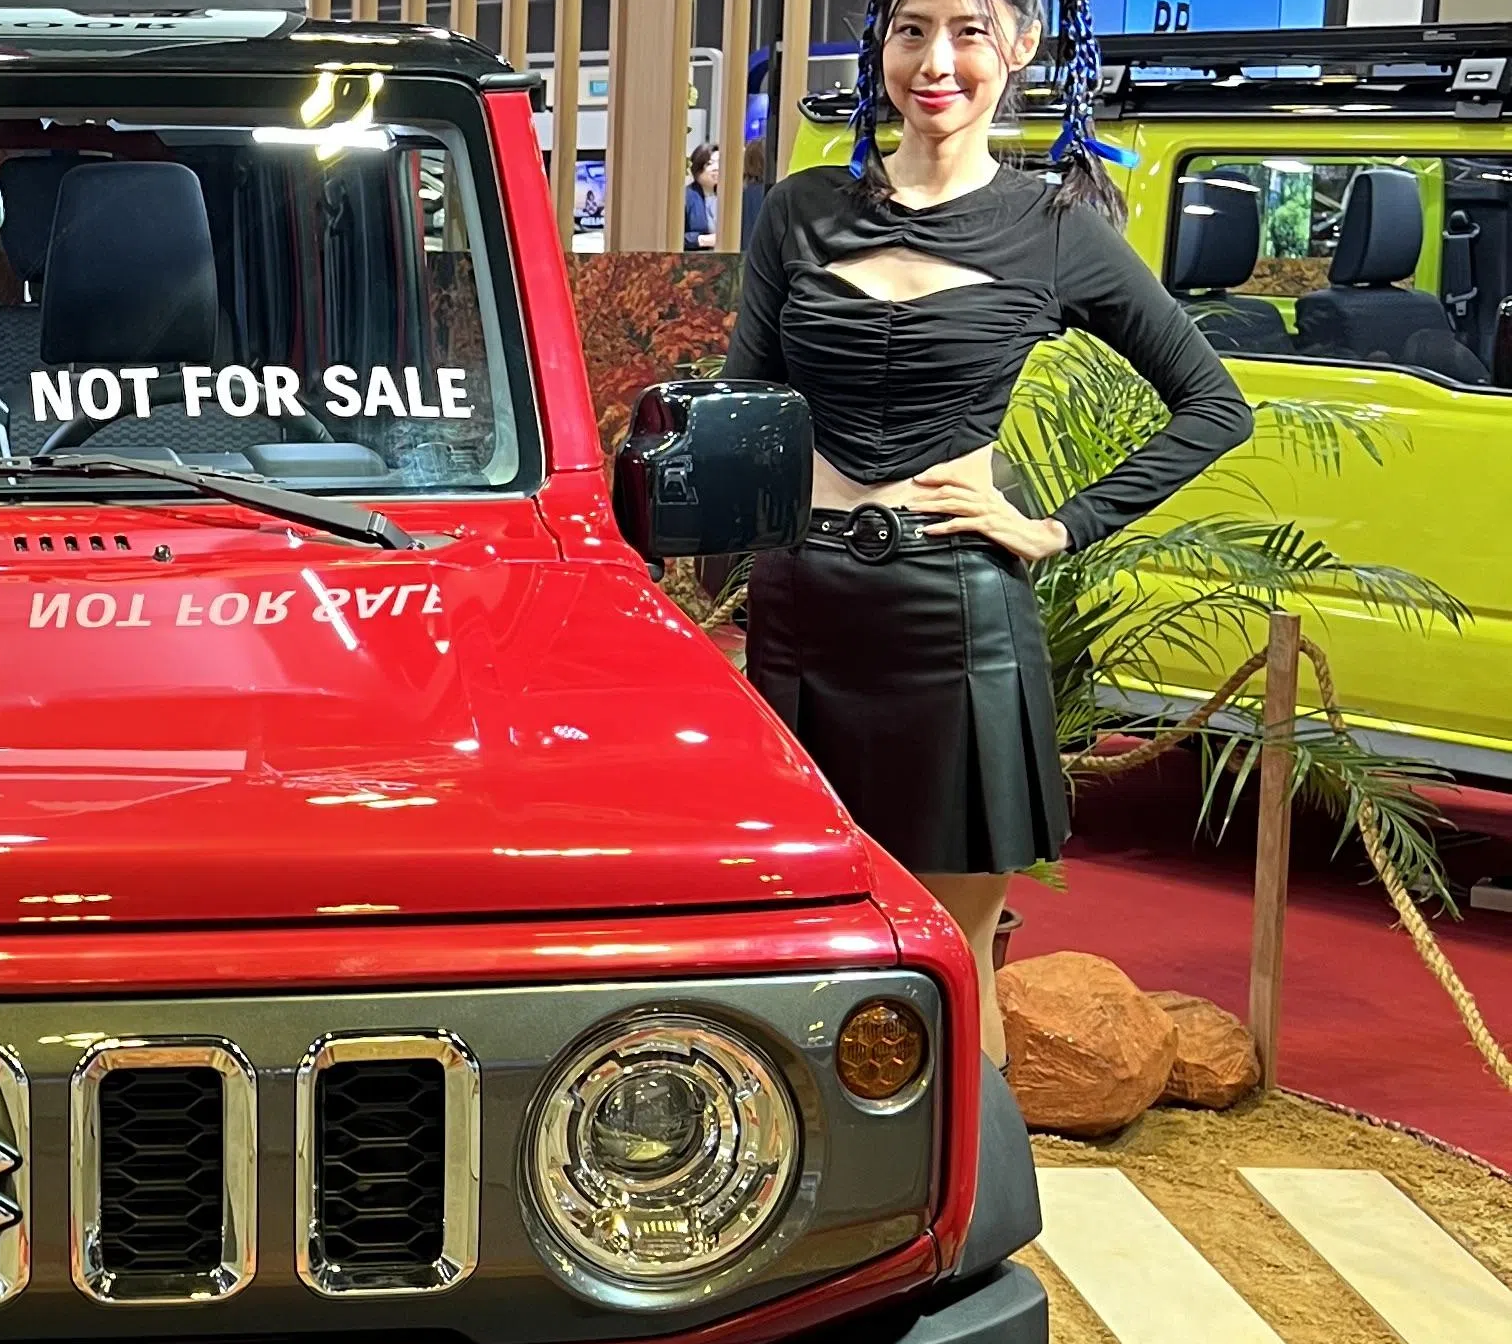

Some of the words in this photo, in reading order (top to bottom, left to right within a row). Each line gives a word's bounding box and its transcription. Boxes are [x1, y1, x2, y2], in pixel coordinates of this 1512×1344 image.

[29, 366, 160, 422] NOT
[181, 364, 307, 420] FOR
[321, 364, 474, 420] SALE
